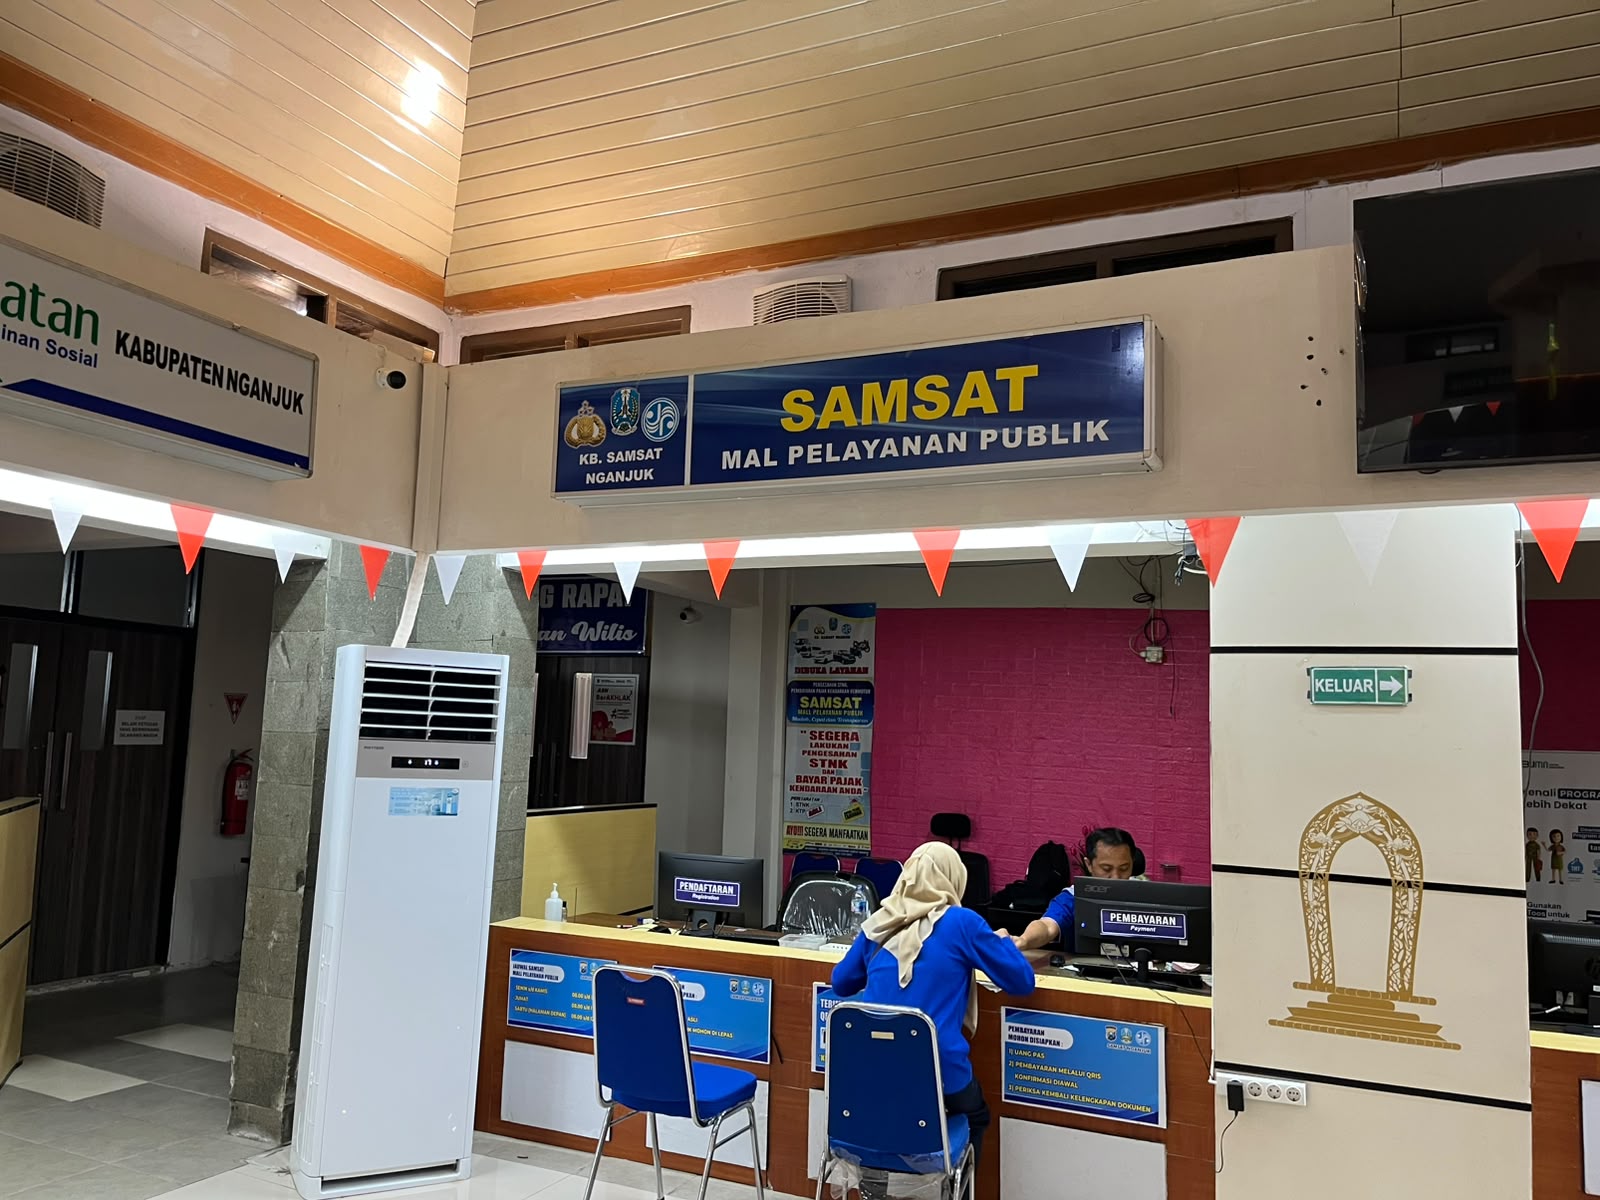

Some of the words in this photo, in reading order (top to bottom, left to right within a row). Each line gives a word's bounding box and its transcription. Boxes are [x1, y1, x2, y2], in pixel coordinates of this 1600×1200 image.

[45, 338, 98, 368] Sosial
[115, 329, 223, 389] KABUPATEN
[226, 370, 304, 415] NGANJUK
[780, 364, 1039, 432] SAMSAT
[721, 443, 778, 471] MAL
[788, 430, 968, 465] PELAYANAN
[978, 418, 1110, 451] PUBLIK
[579, 453, 602, 465] KB.
[606, 447, 663, 463] SAMSAT
[586, 468, 654, 484] NGANJUK
[562, 583, 632, 608] RAPA
[1315, 679, 1374, 693] KELUAR
[800, 696, 862, 709] SAMSAT
[809, 759, 848, 769] STNK
[795, 775, 827, 784] BAYAR
[829, 777, 862, 786] PAJAK
[789, 785, 837, 794] KENDARAAN
[1527, 788, 1557, 797] enali
[1526, 800, 1551, 809] ebih
[1554, 801, 1588, 810] Dekat
[804, 826, 827, 838] SEGERA
[829, 828, 868, 840] MANFAATKAN
[680, 881, 734, 894] PENDAFTARAN
[1084, 885, 1112, 893] acer
[1527, 901, 1561, 910] Gunakan
[1110, 912, 1176, 925] PEMBAYARAN
[1548, 911, 1570, 919] untuk
[693, 1028, 711, 1036] MOHON
[1008, 1025, 1045, 1036] PEMBAYARAN
[1008, 1034, 1029, 1043] MOHON
[1030, 1036, 1060, 1047] DISIAPKAN
[1014, 1049, 1032, 1058] UANG
[1015, 1061, 1057, 1073] PEMBAYARAN
[1058, 1068, 1085, 1077] MELALUI
[1086, 1071, 1102, 1080] QRIS
[1014, 1073, 1052, 1085] KONFIRMASI
[1053, 1078, 1079, 1089] DIAWAL
[1014, 1085, 1040, 1095] PERIKSA
[1041, 1090, 1069, 1100] KEMBALI
[1070, 1094, 1117, 1108] KELENGKAPAN
[1117, 1101, 1152, 1113] DOKUMEN
